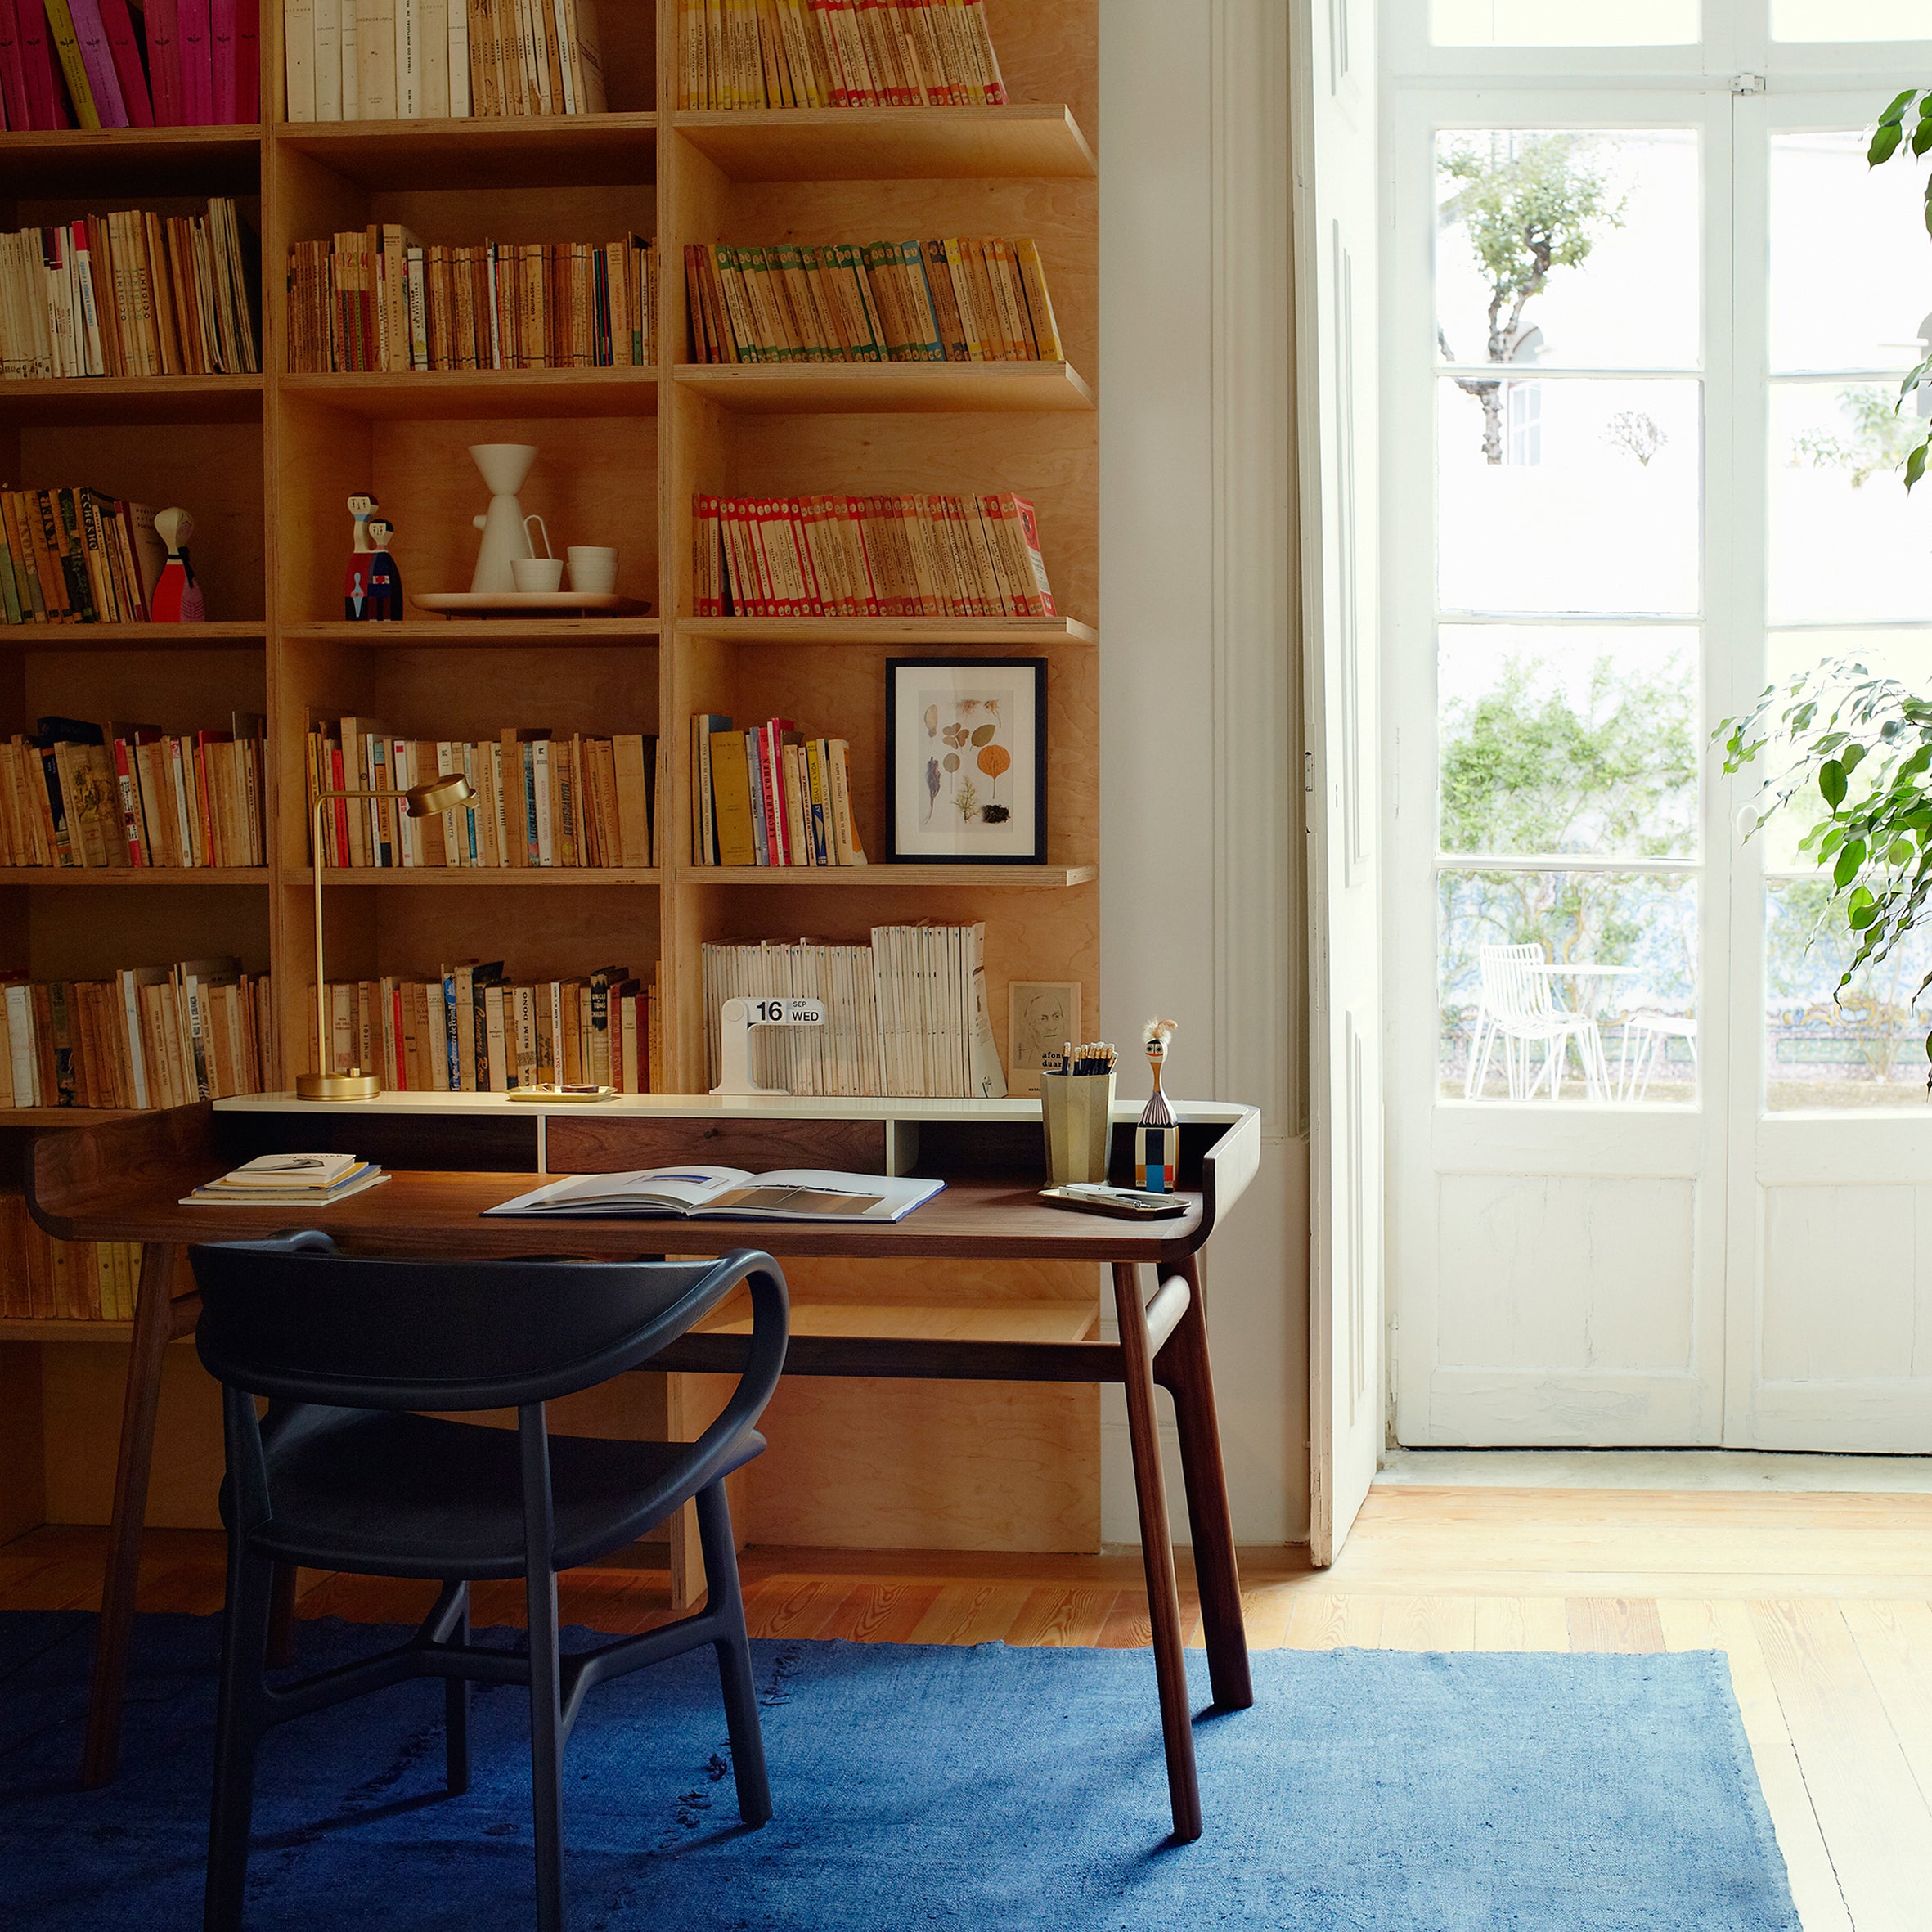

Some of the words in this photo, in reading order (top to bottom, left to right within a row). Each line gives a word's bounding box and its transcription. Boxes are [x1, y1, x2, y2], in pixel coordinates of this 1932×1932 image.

[762, 757, 772, 792] COHEN
[765, 793, 775, 838] LEONARD
[756, 1002, 783, 1022] 16
[792, 1011, 819, 1022] WED
